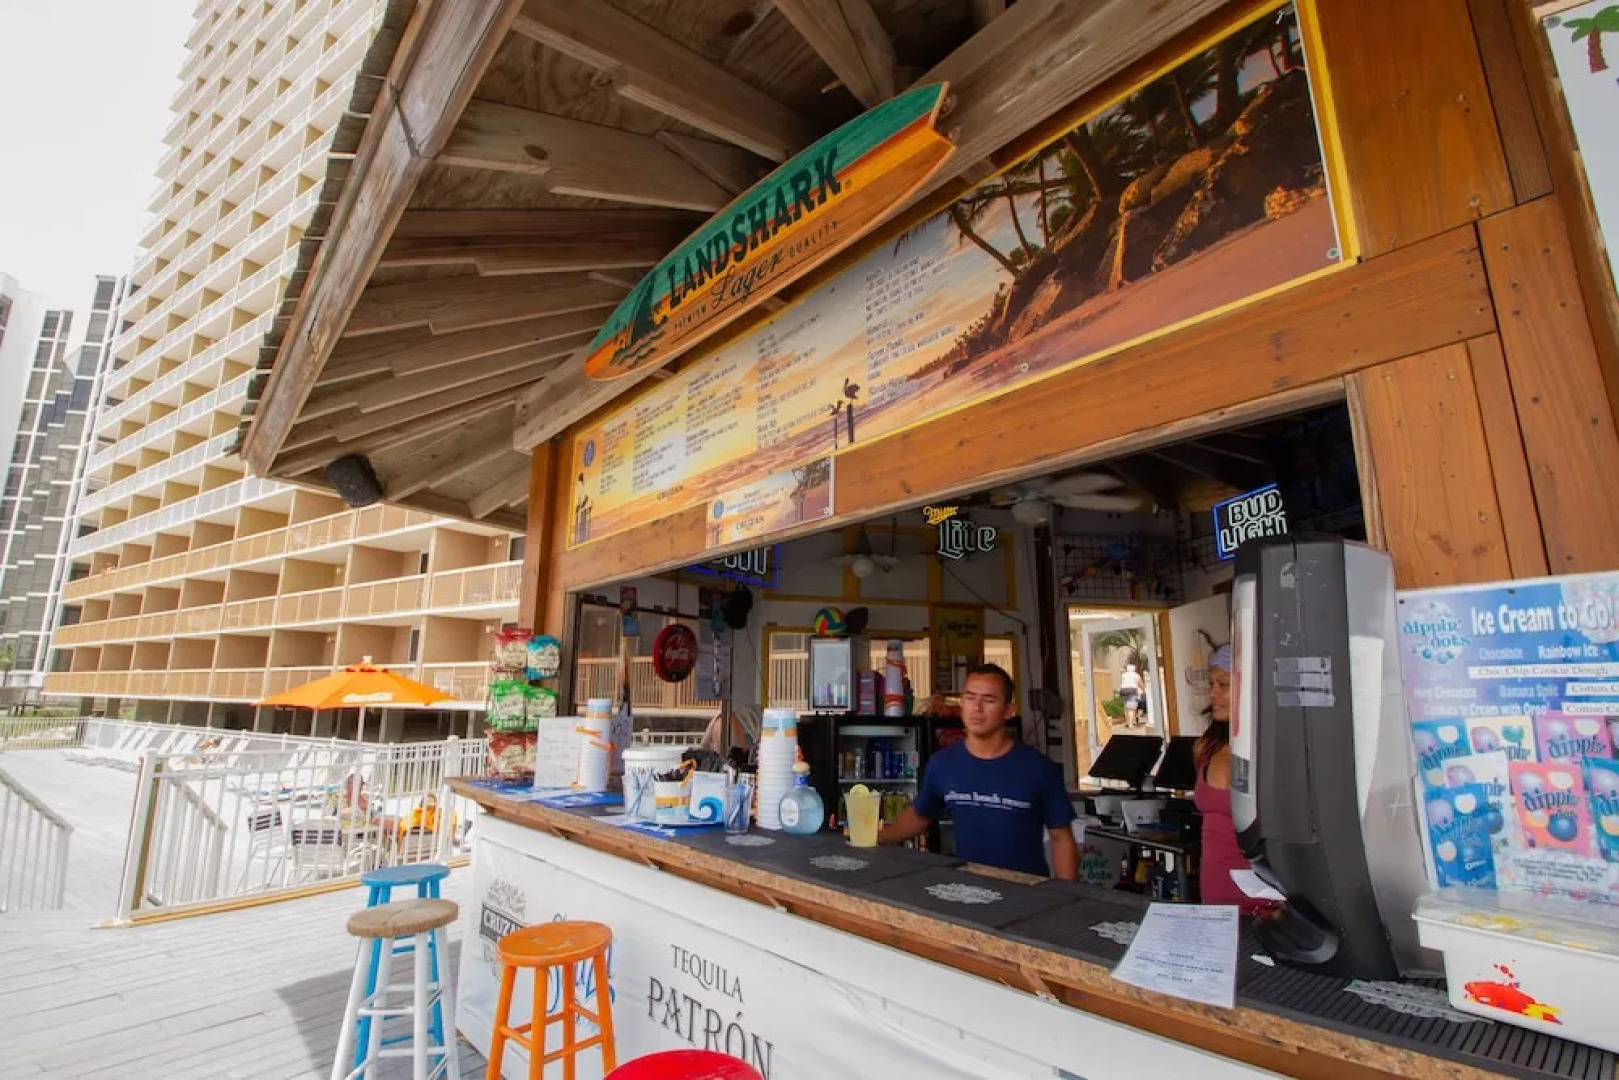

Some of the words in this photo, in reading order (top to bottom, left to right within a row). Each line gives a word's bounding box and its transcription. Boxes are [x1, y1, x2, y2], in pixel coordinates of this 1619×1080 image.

[666, 147, 842, 309] LANDSHARK
[710, 249, 785, 309] Lager
[1228, 489, 1283, 526] BUD
[937, 519, 997, 560] Lite
[1472, 606, 1496, 636] Ice
[1499, 603, 1555, 634] Cream
[1558, 601, 1579, 631] to
[1430, 634, 1471, 648] dots
[1532, 667, 1569, 676] Cookie
[1572, 666, 1609, 676] Dough
[484, 909, 523, 937] CRUZ
[671, 943, 744, 1003] TEQUILA
[647, 975, 774, 1080] PATRÓN
